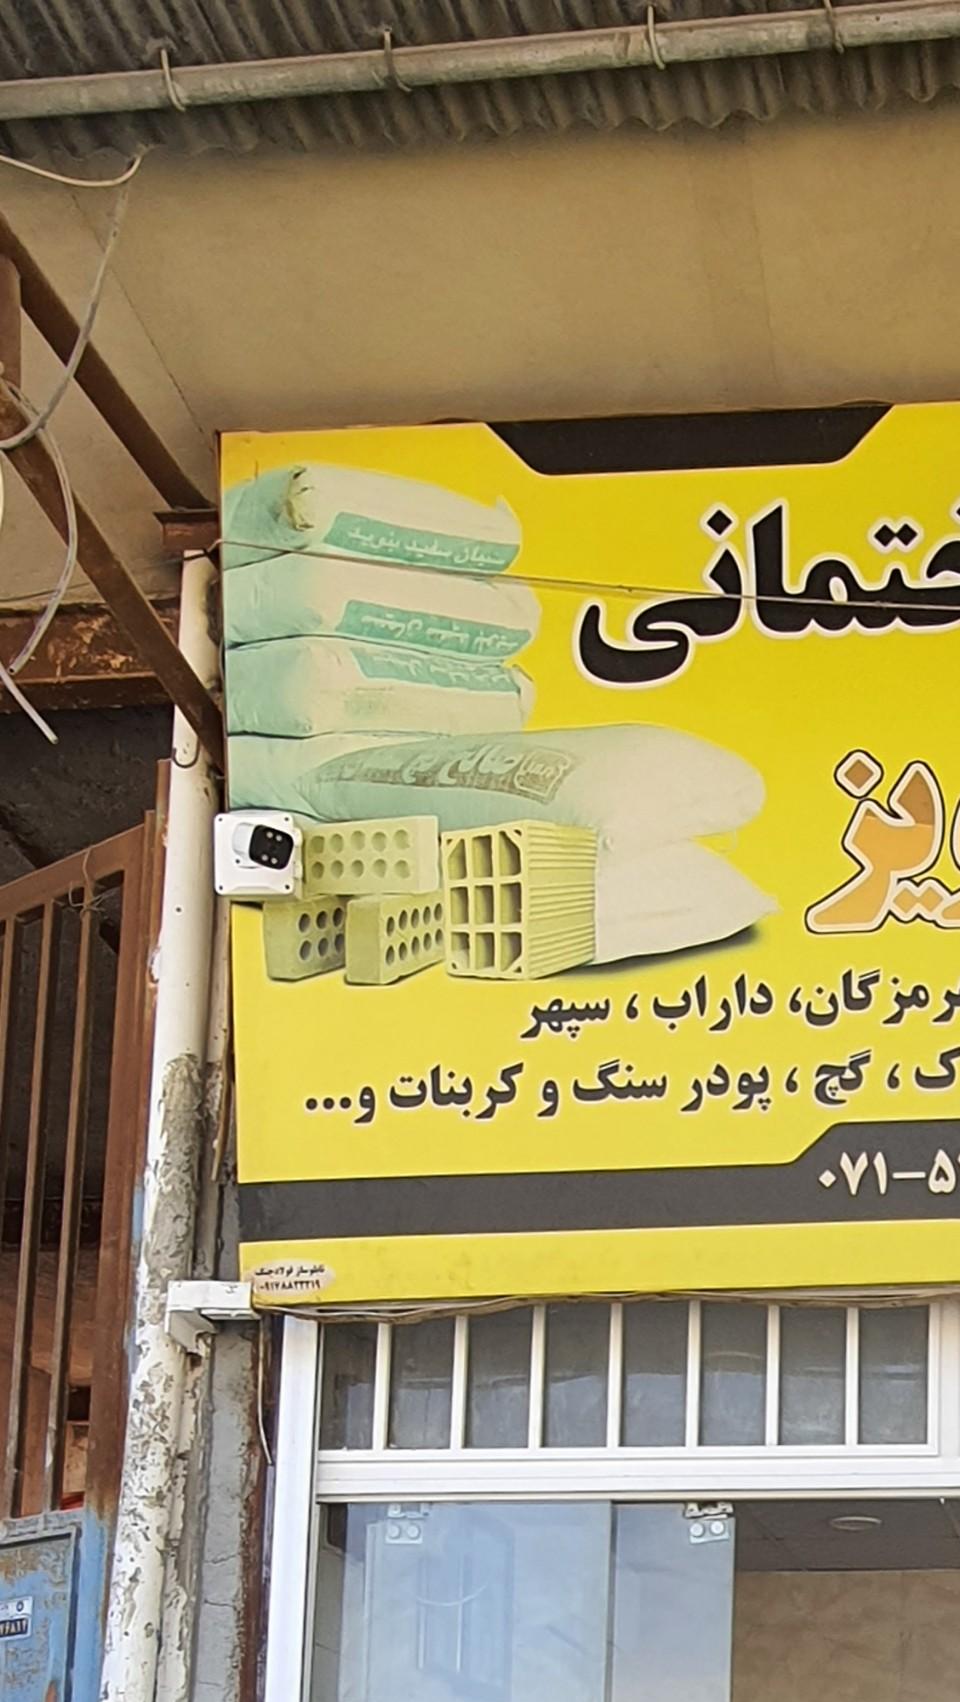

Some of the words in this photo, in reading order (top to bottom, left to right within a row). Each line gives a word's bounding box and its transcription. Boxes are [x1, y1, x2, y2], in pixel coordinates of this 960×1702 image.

[520, 998, 610, 1039] سپهر
[389, 1062, 524, 1119] کربنات
[537, 1079, 559, 1118] و
[572, 1059, 667, 1102] سنگ
[680, 1063, 772, 1112] پودر
